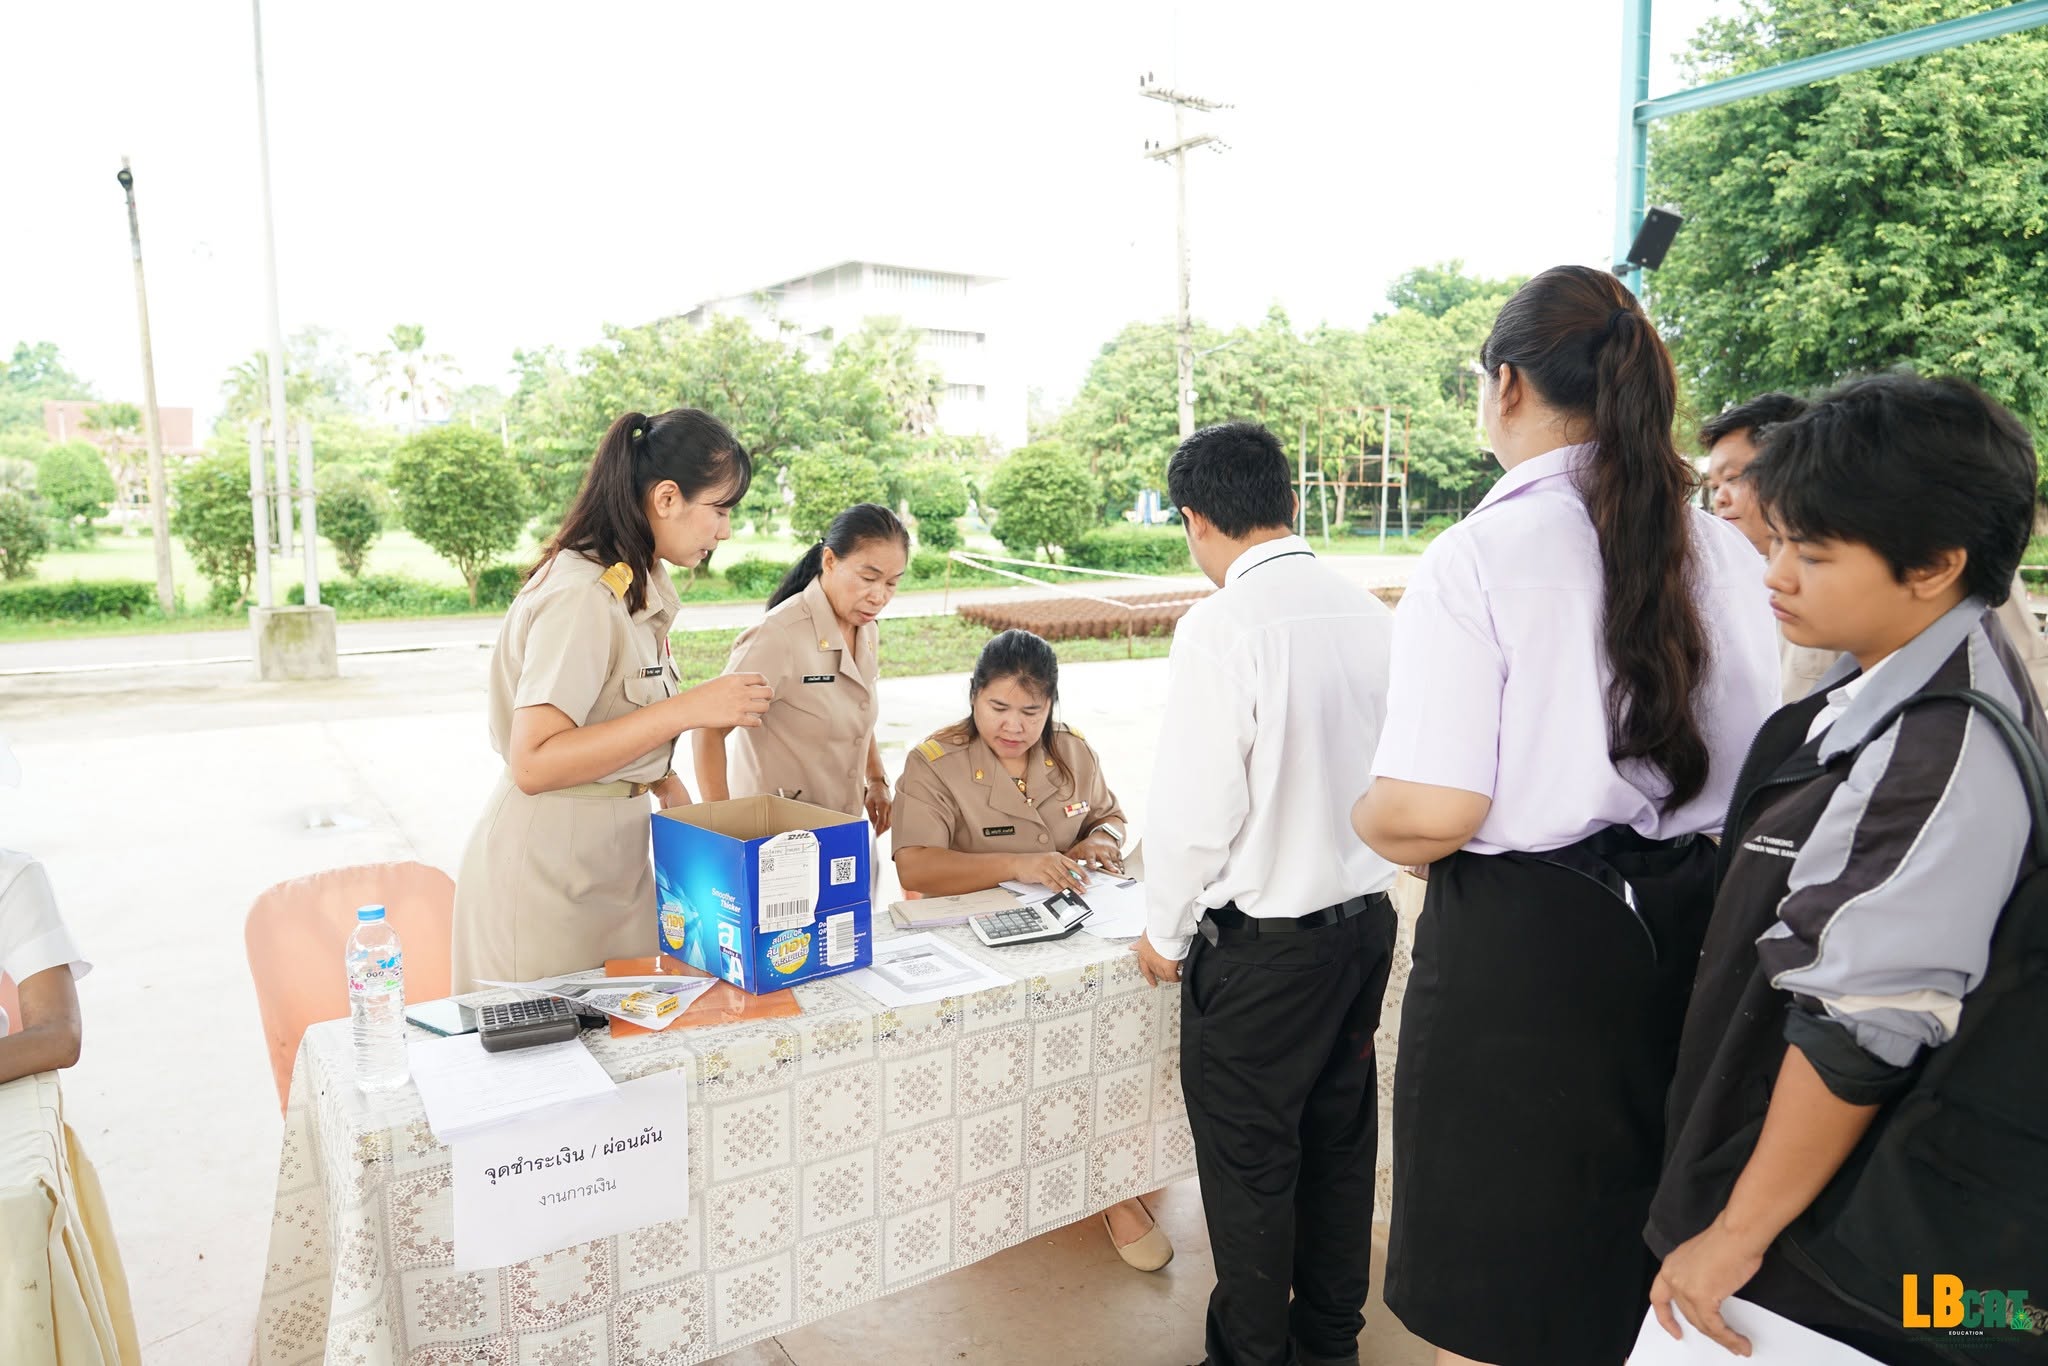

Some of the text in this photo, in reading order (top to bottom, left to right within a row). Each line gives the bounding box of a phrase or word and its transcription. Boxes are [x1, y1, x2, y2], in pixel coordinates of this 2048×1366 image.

[787, 832, 811, 841] DHL
[711, 887, 736, 903] Smoother
[720, 899, 741, 913] Thicker
[484, 1126, 663, 1186] จุดชำระเงิน / ผ่อนผัน
[538, 1177, 617, 1206] งานการเงิน
